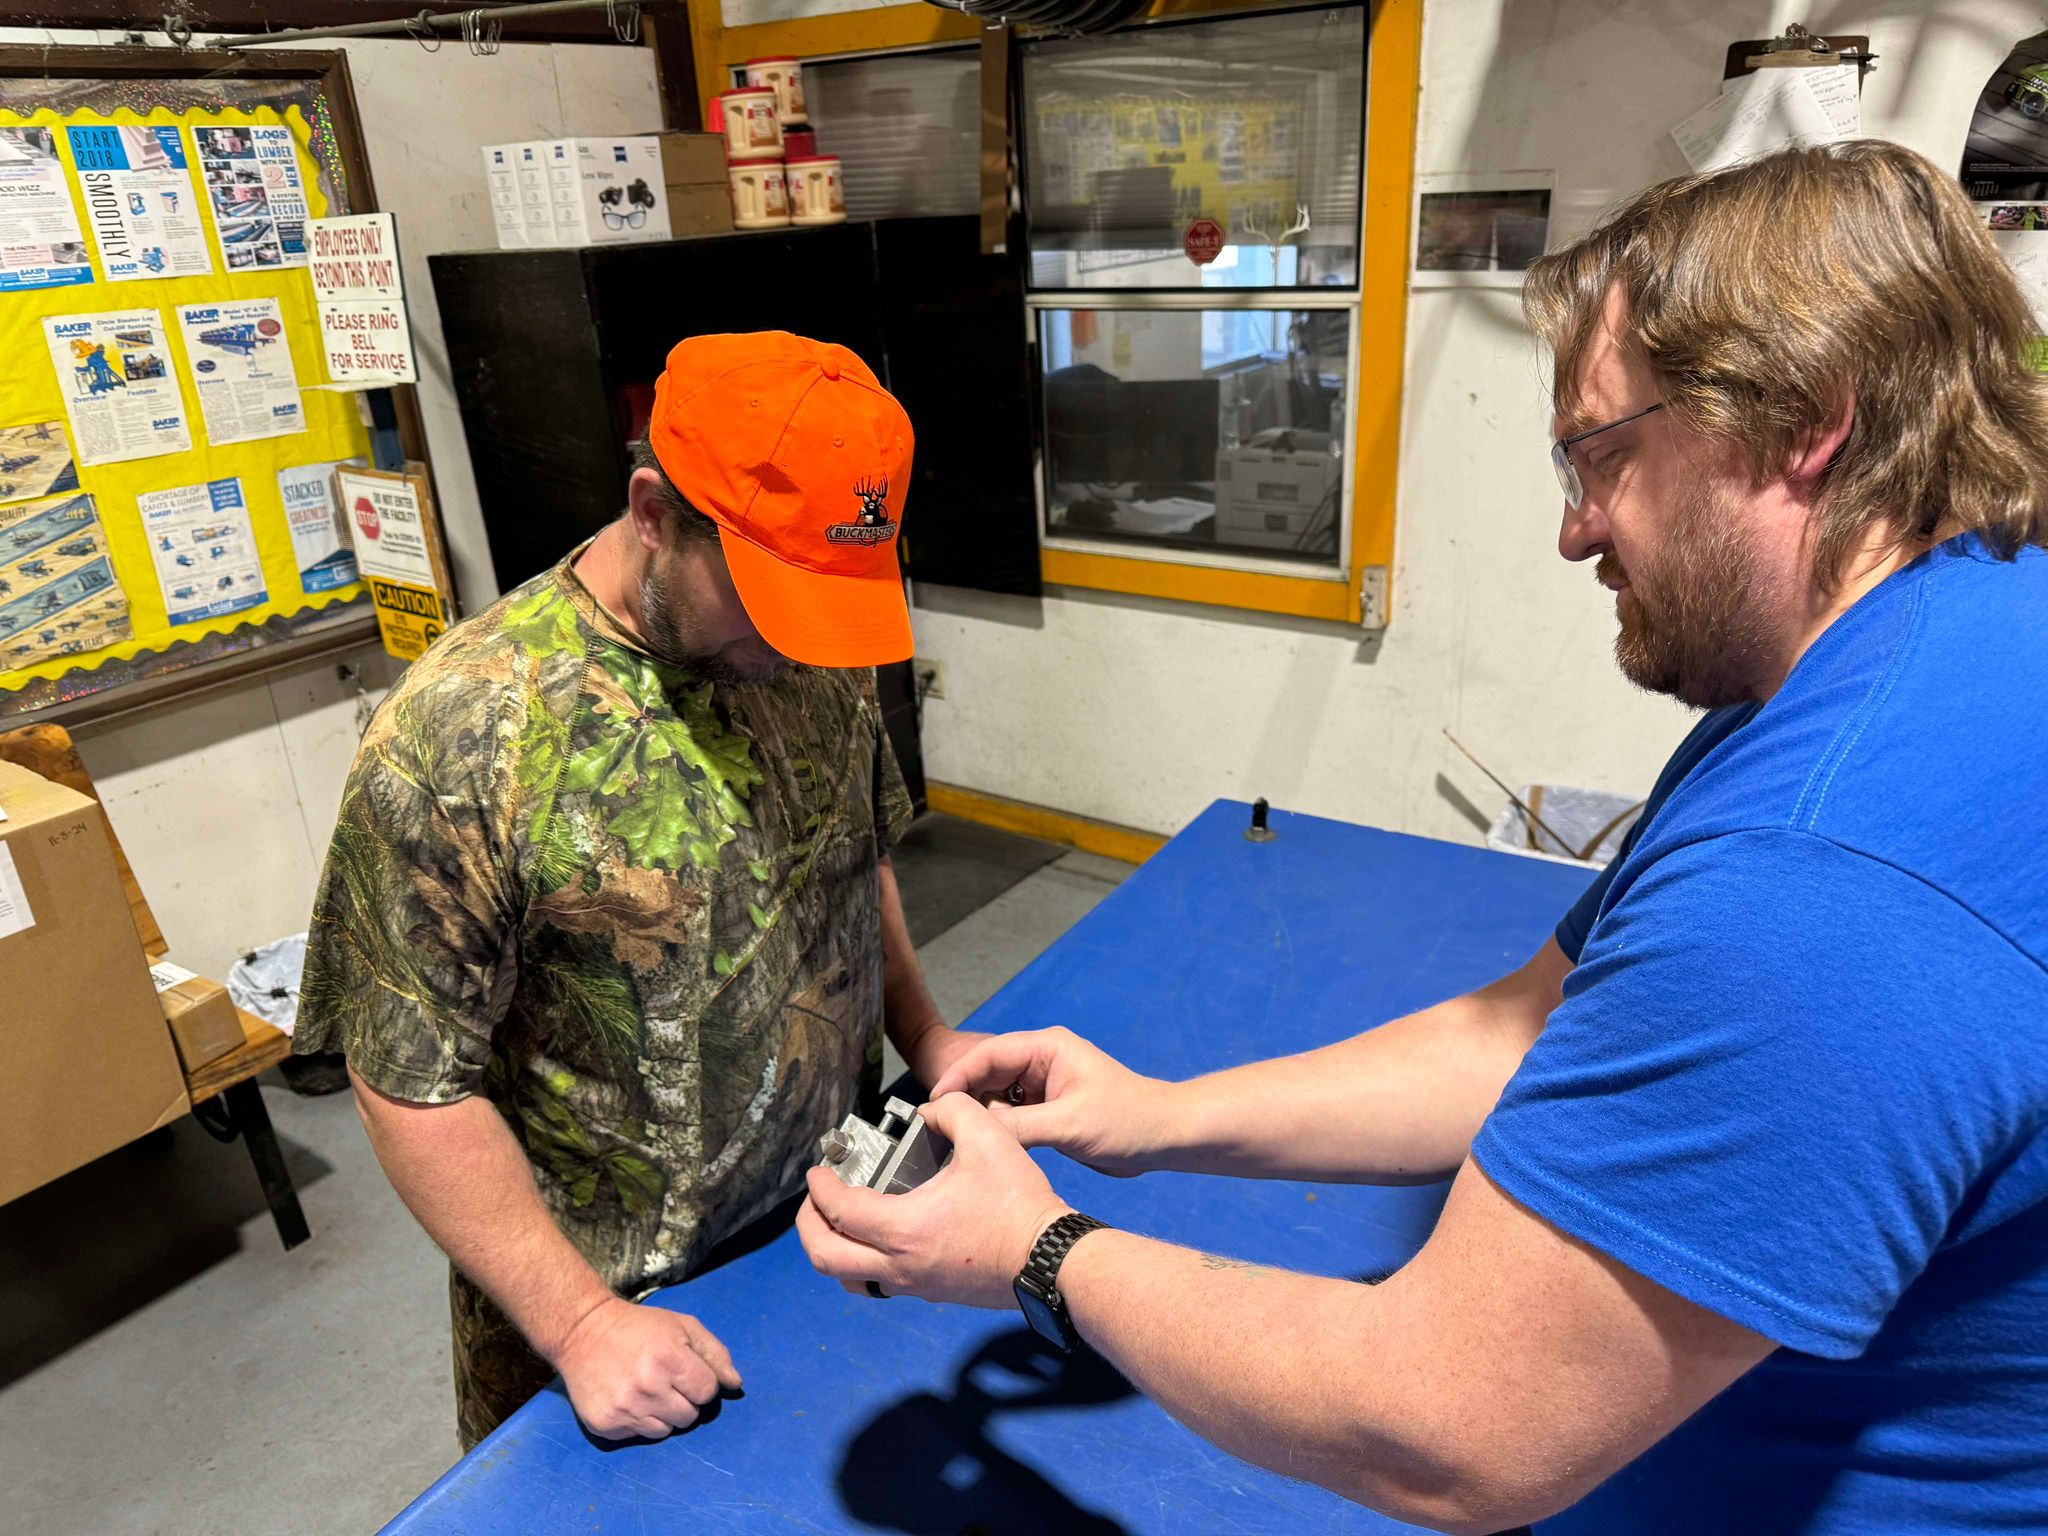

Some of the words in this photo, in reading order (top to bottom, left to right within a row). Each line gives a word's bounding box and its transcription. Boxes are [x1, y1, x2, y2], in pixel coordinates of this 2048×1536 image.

[73, 130, 119, 148] START
[253, 130, 288, 139] LOGS
[77, 150, 113, 167] 2018
[257, 146, 293, 158] LUMBER
[263, 166, 286, 189] 2
[84, 173, 131, 258] SMOOTHLY
[271, 203, 305, 215] RECORD
[314, 228, 361, 257] EMPLOYEES
[360, 227, 383, 255] ONLY
[109, 263, 139, 272] BAKER
[313, 261, 346, 289] BEYOND
[345, 261, 366, 288] THIS
[367, 260, 395, 288] POINT
[184, 308, 219, 320] BAKER
[325, 313, 366, 331] PLEASE
[369, 313, 399, 330] RING
[54, 322, 92, 334] BAKER
[351, 334, 376, 350] BELL
[331, 353, 354, 369] FOR
[356, 354, 407, 370] SERVICE
[283, 480, 325, 503] STACKED
[356, 509, 378, 528] STOP
[376, 584, 438, 618] CAUTION
